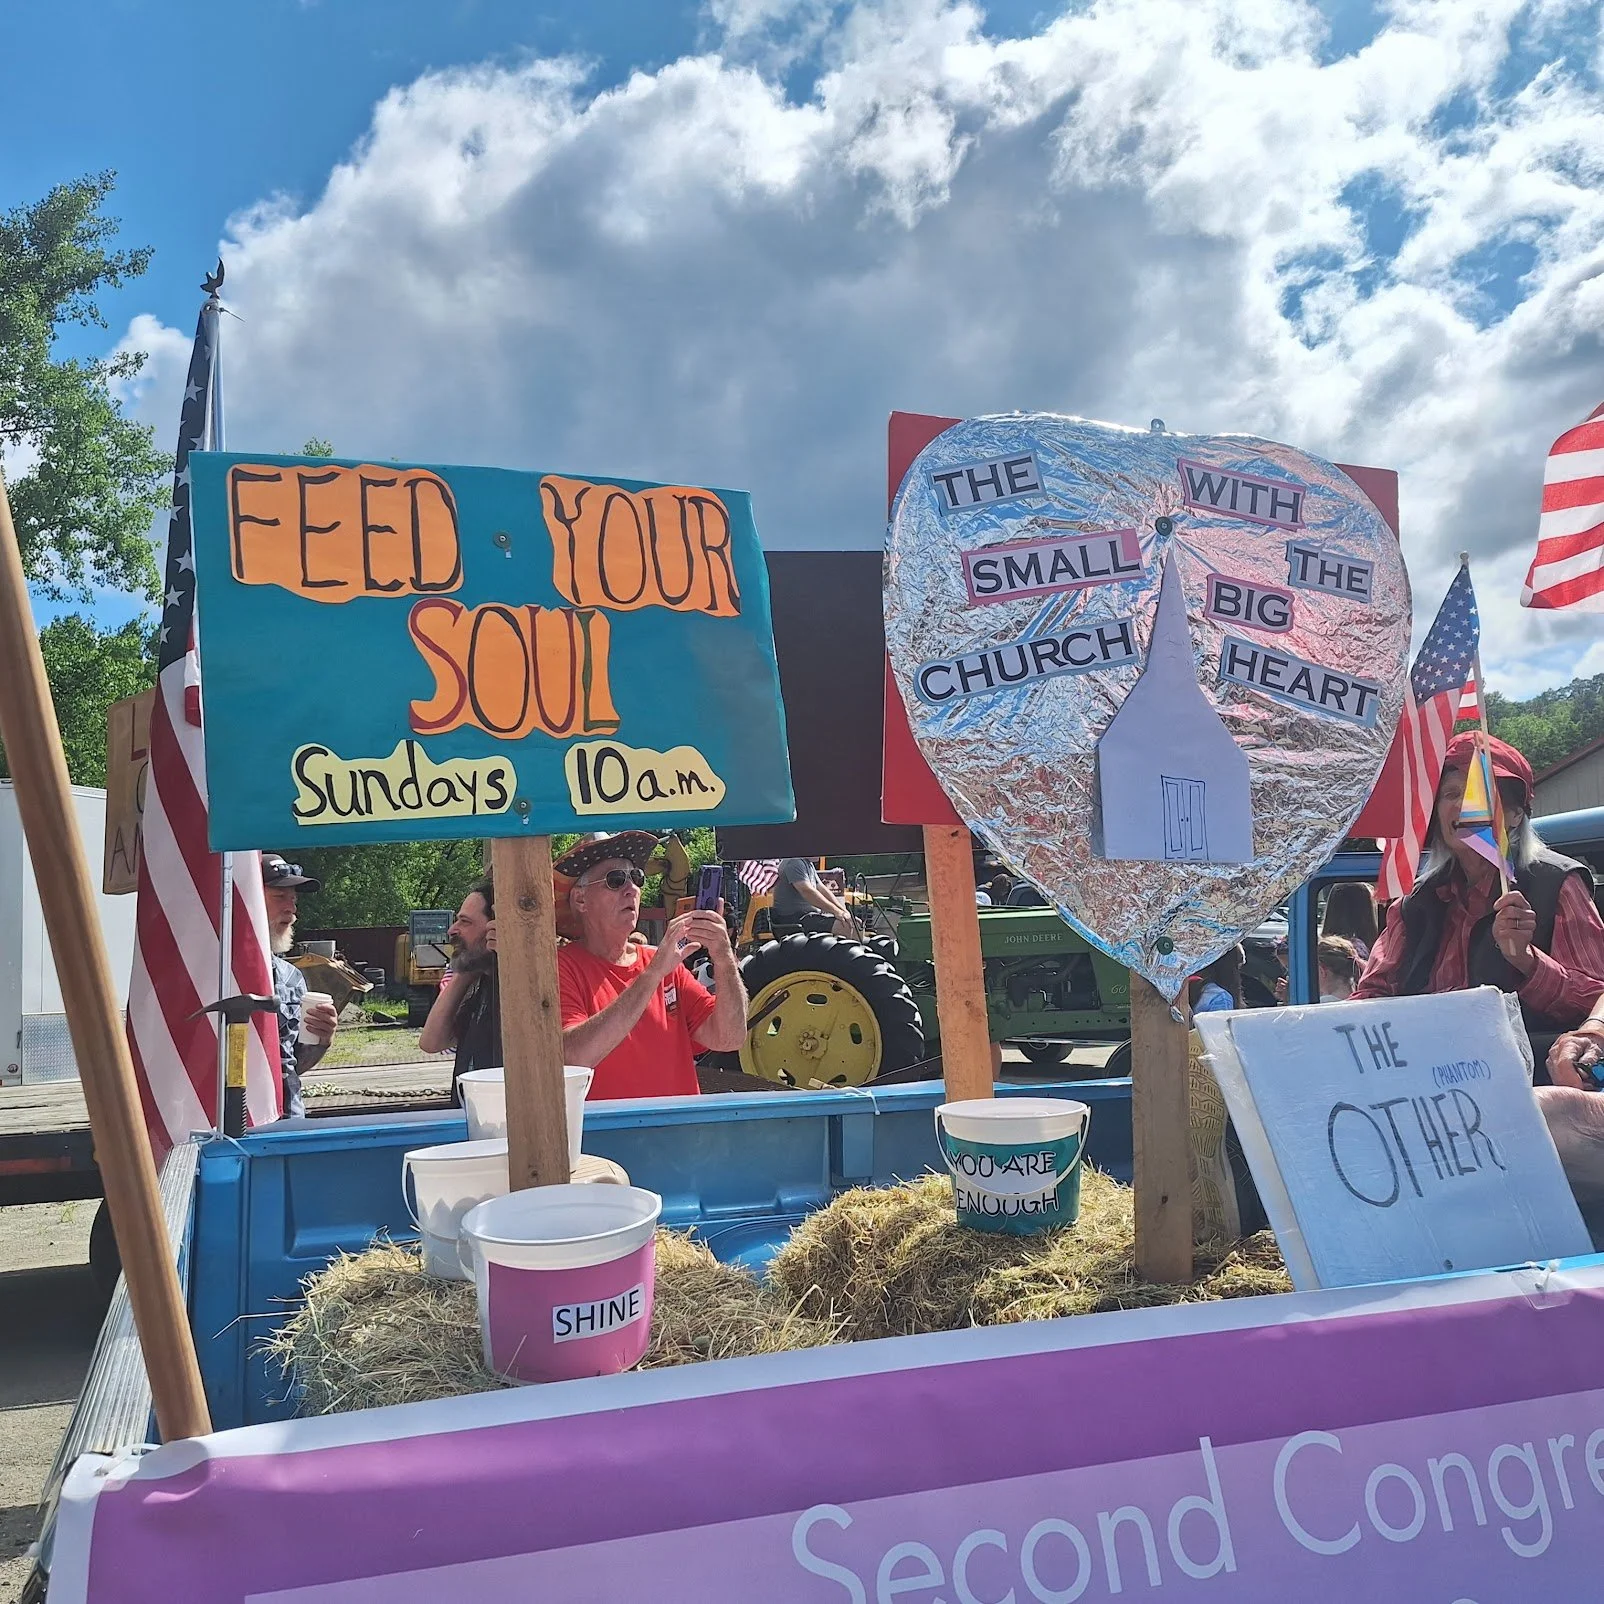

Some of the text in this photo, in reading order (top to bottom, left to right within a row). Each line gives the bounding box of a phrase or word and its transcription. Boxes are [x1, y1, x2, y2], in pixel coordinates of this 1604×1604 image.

[932, 455, 1040, 507] THE
[1183, 465, 1303, 523] WITH
[230, 470, 741, 616] FEED YOUR
[971, 538, 1141, 595] SMALL
[1292, 545, 1371, 595] THE
[1212, 579, 1290, 629] BIG
[408, 598, 620, 734] SOUL
[919, 622, 1134, 701] CHURCH
[1226, 643, 1379, 718] HEART
[292, 739, 509, 818] Sundays
[1004, 932, 1063, 944] JOHN DEERE
[1332, 1021, 1408, 1074] THE
[1432, 1058, 1492, 1089] (PHANTOM)
[950, 1151, 1056, 1178] YOU ARE
[1327, 1088, 1507, 1208] OTHER
[955, 1187, 1059, 1216] ENOUGH
[555, 1288, 640, 1337] SHINE
[791, 1435, 1239, 1604] Second
